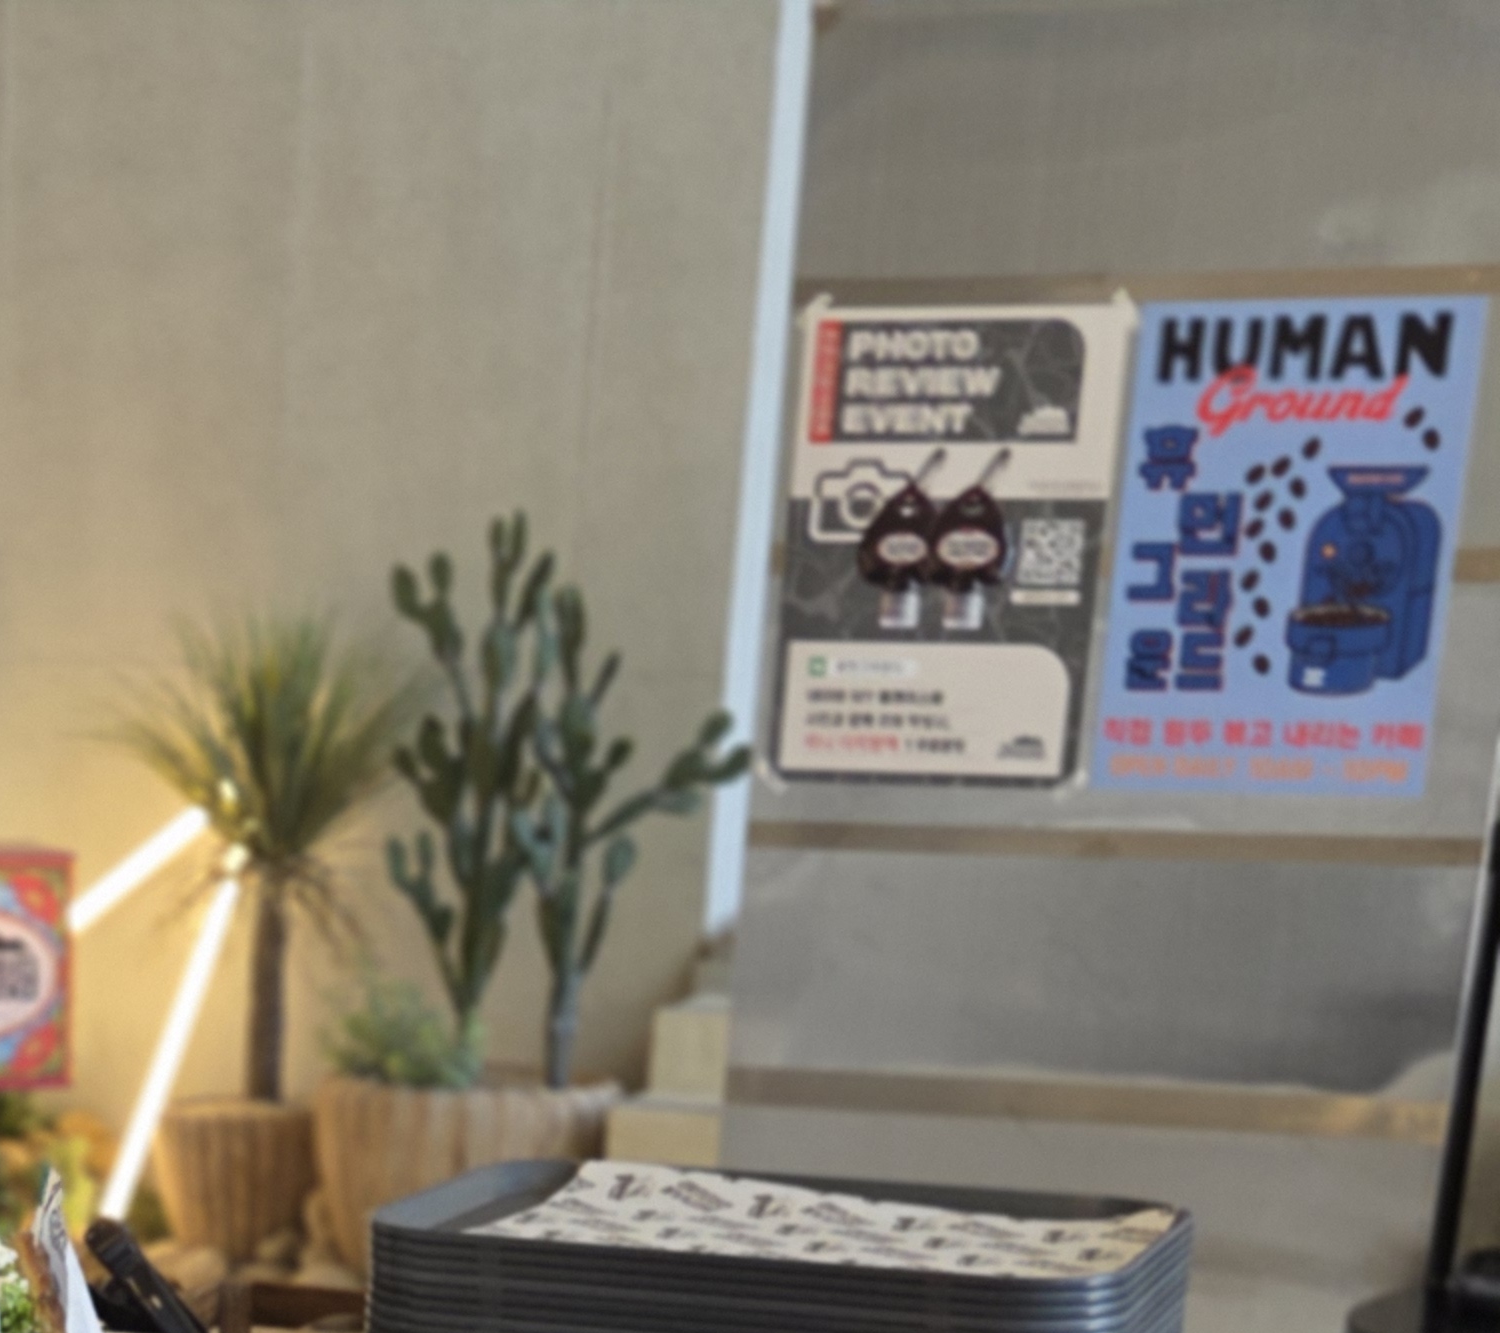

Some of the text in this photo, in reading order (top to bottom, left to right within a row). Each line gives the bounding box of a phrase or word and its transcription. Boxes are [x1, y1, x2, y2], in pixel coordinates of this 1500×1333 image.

[848, 328, 981, 362] PHOTO
[1156, 308, 1455, 385] HUMAN
[844, 365, 1002, 398] REVIEW
[1196, 362, 1410, 437] Ground
[840, 402, 974, 434] EVENT
